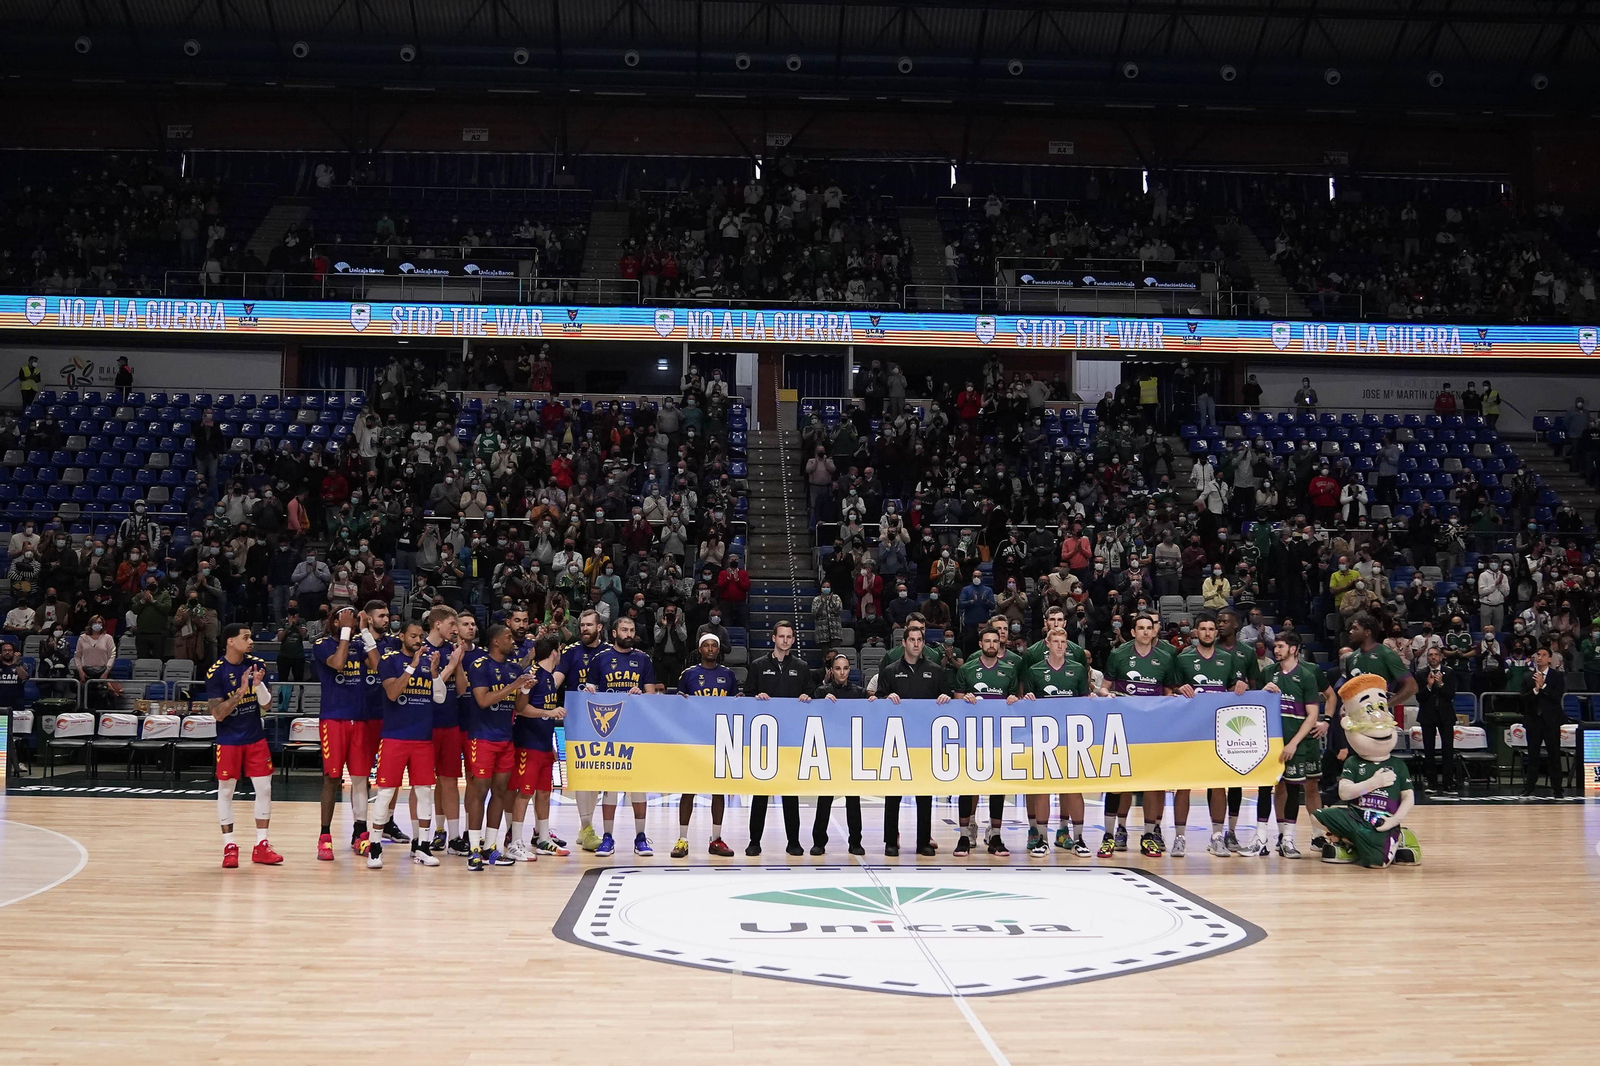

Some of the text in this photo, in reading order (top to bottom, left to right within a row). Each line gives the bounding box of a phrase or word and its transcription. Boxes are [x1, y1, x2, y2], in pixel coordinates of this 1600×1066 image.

[58, 298, 226, 331] NO A LA GUERRA
[391, 306, 544, 338] STOP THE WAR
[687, 310, 854, 342] NO A LA GUERRA
[1015, 318, 1165, 350] STOP THE WAR
[1302, 324, 1463, 356] NO A LA GUERRA
[98, 367, 135, 375] MALA
[408, 676, 432, 690] CAM
[605, 670, 640, 682] UCAM
[694, 687, 728, 697] UCAM
[574, 741, 634, 761] UCAM
[714, 713, 1133, 782] NO A LA GUERRA
[1226, 738, 1257, 747] Unicaja
[575, 761, 633, 771] UNIVERSIDAD
[740, 919, 1081, 936] Unicaja
